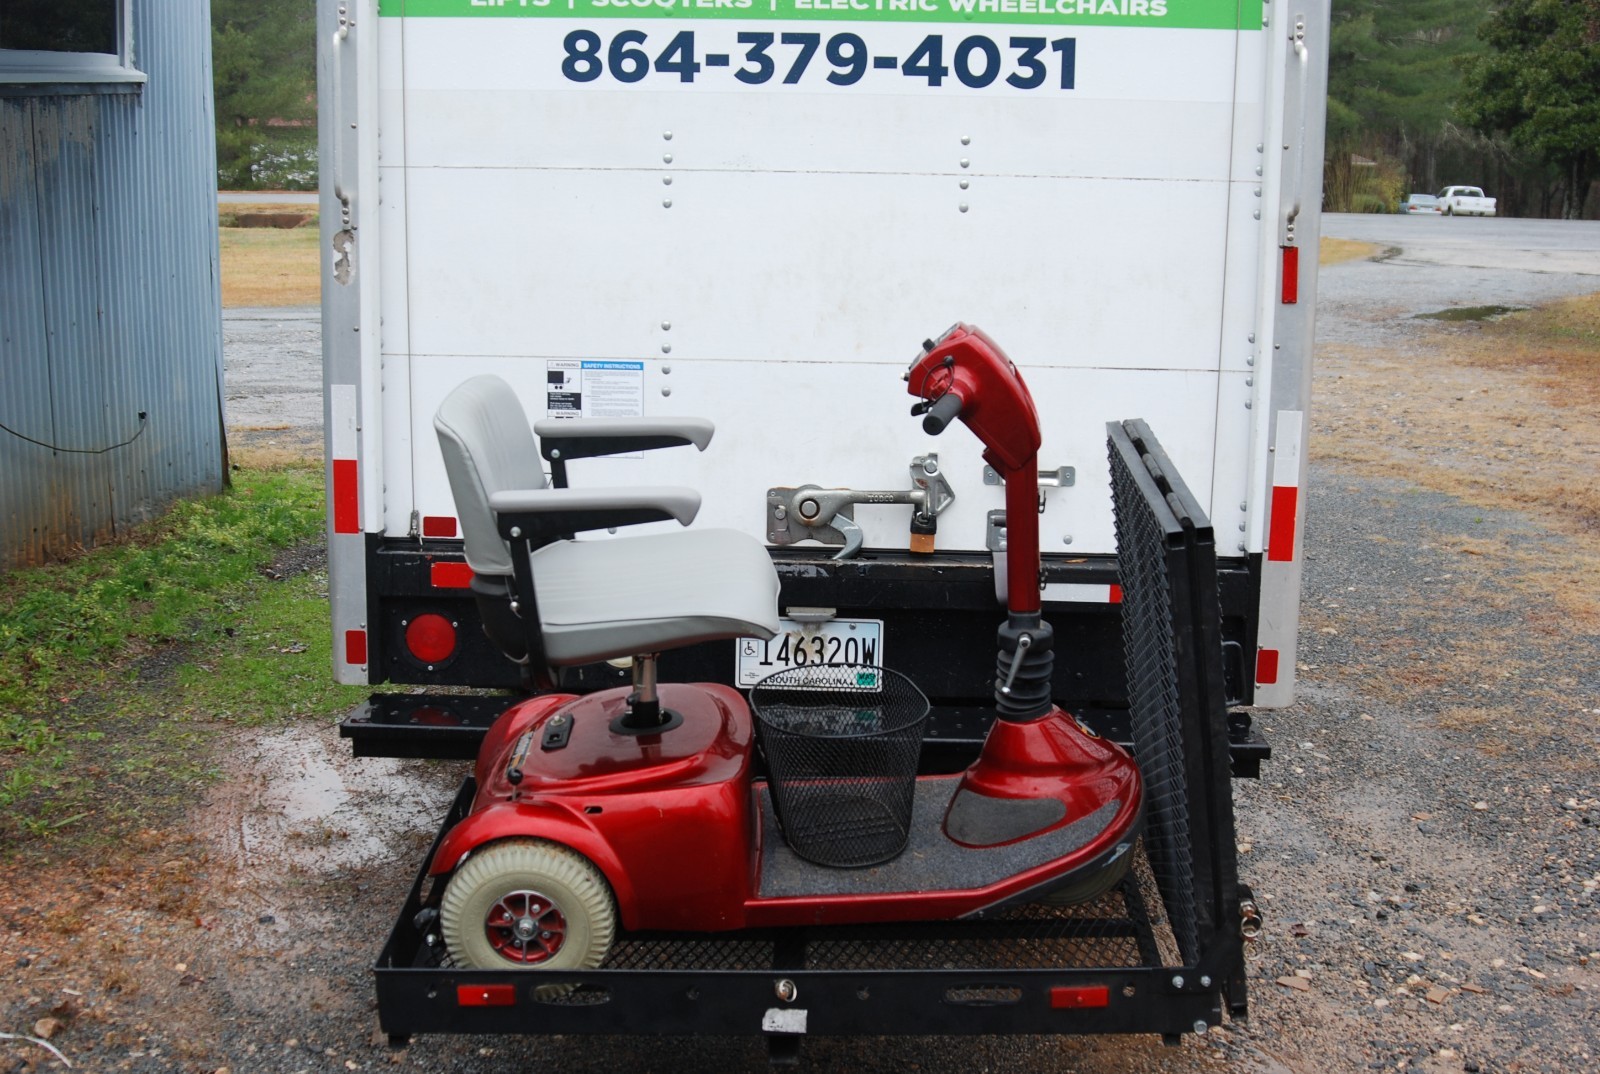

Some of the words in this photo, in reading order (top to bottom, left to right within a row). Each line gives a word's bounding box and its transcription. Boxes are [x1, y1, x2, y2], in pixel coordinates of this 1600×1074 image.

[949, 0, 1168, 16] WHEELCHAIRS
[562, 29, 1076, 90] 864-379-4031
[769, 676, 800, 685] SOUTH
[802, 677, 848, 686] CAROLINA
